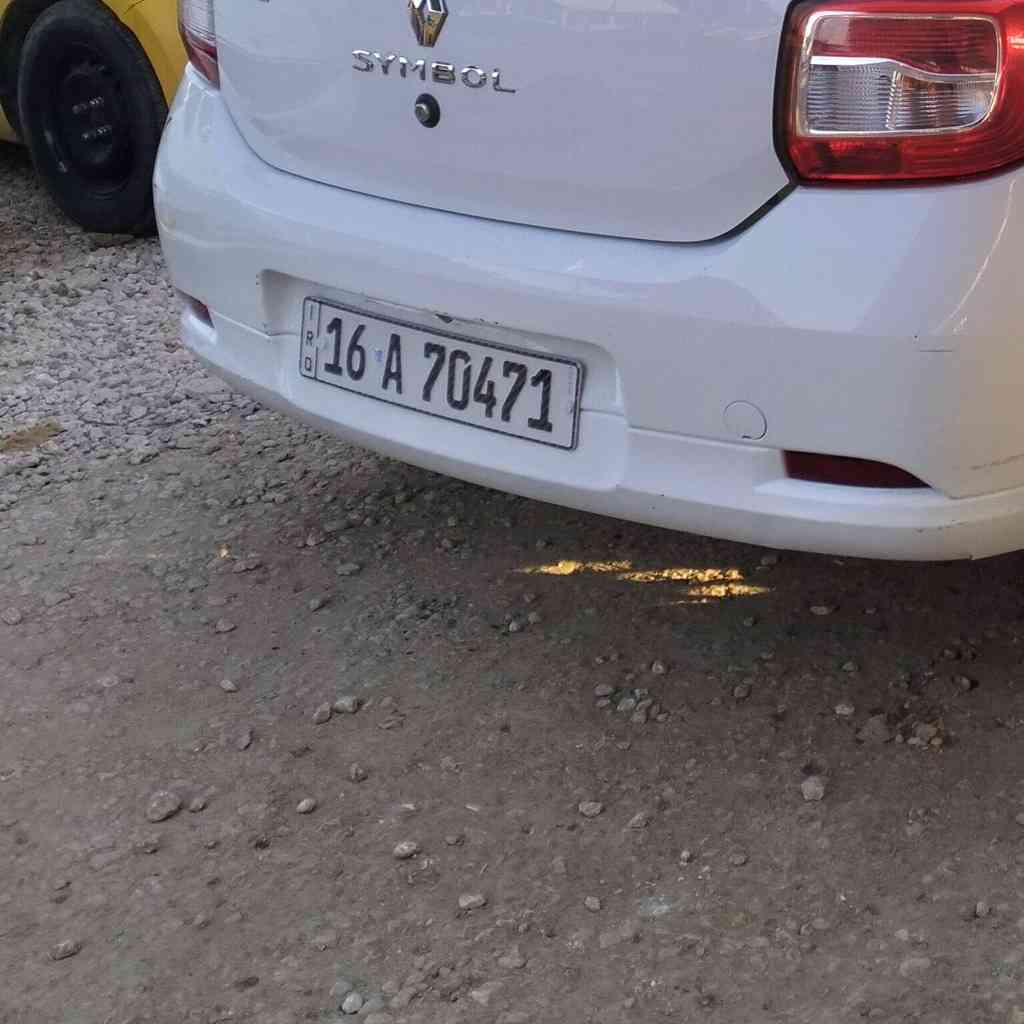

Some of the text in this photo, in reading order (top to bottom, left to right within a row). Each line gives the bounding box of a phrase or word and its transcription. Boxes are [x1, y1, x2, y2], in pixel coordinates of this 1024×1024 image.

[352, 49, 516, 94] SYMBOL
[324, 317, 553, 433] 16 A 70471
